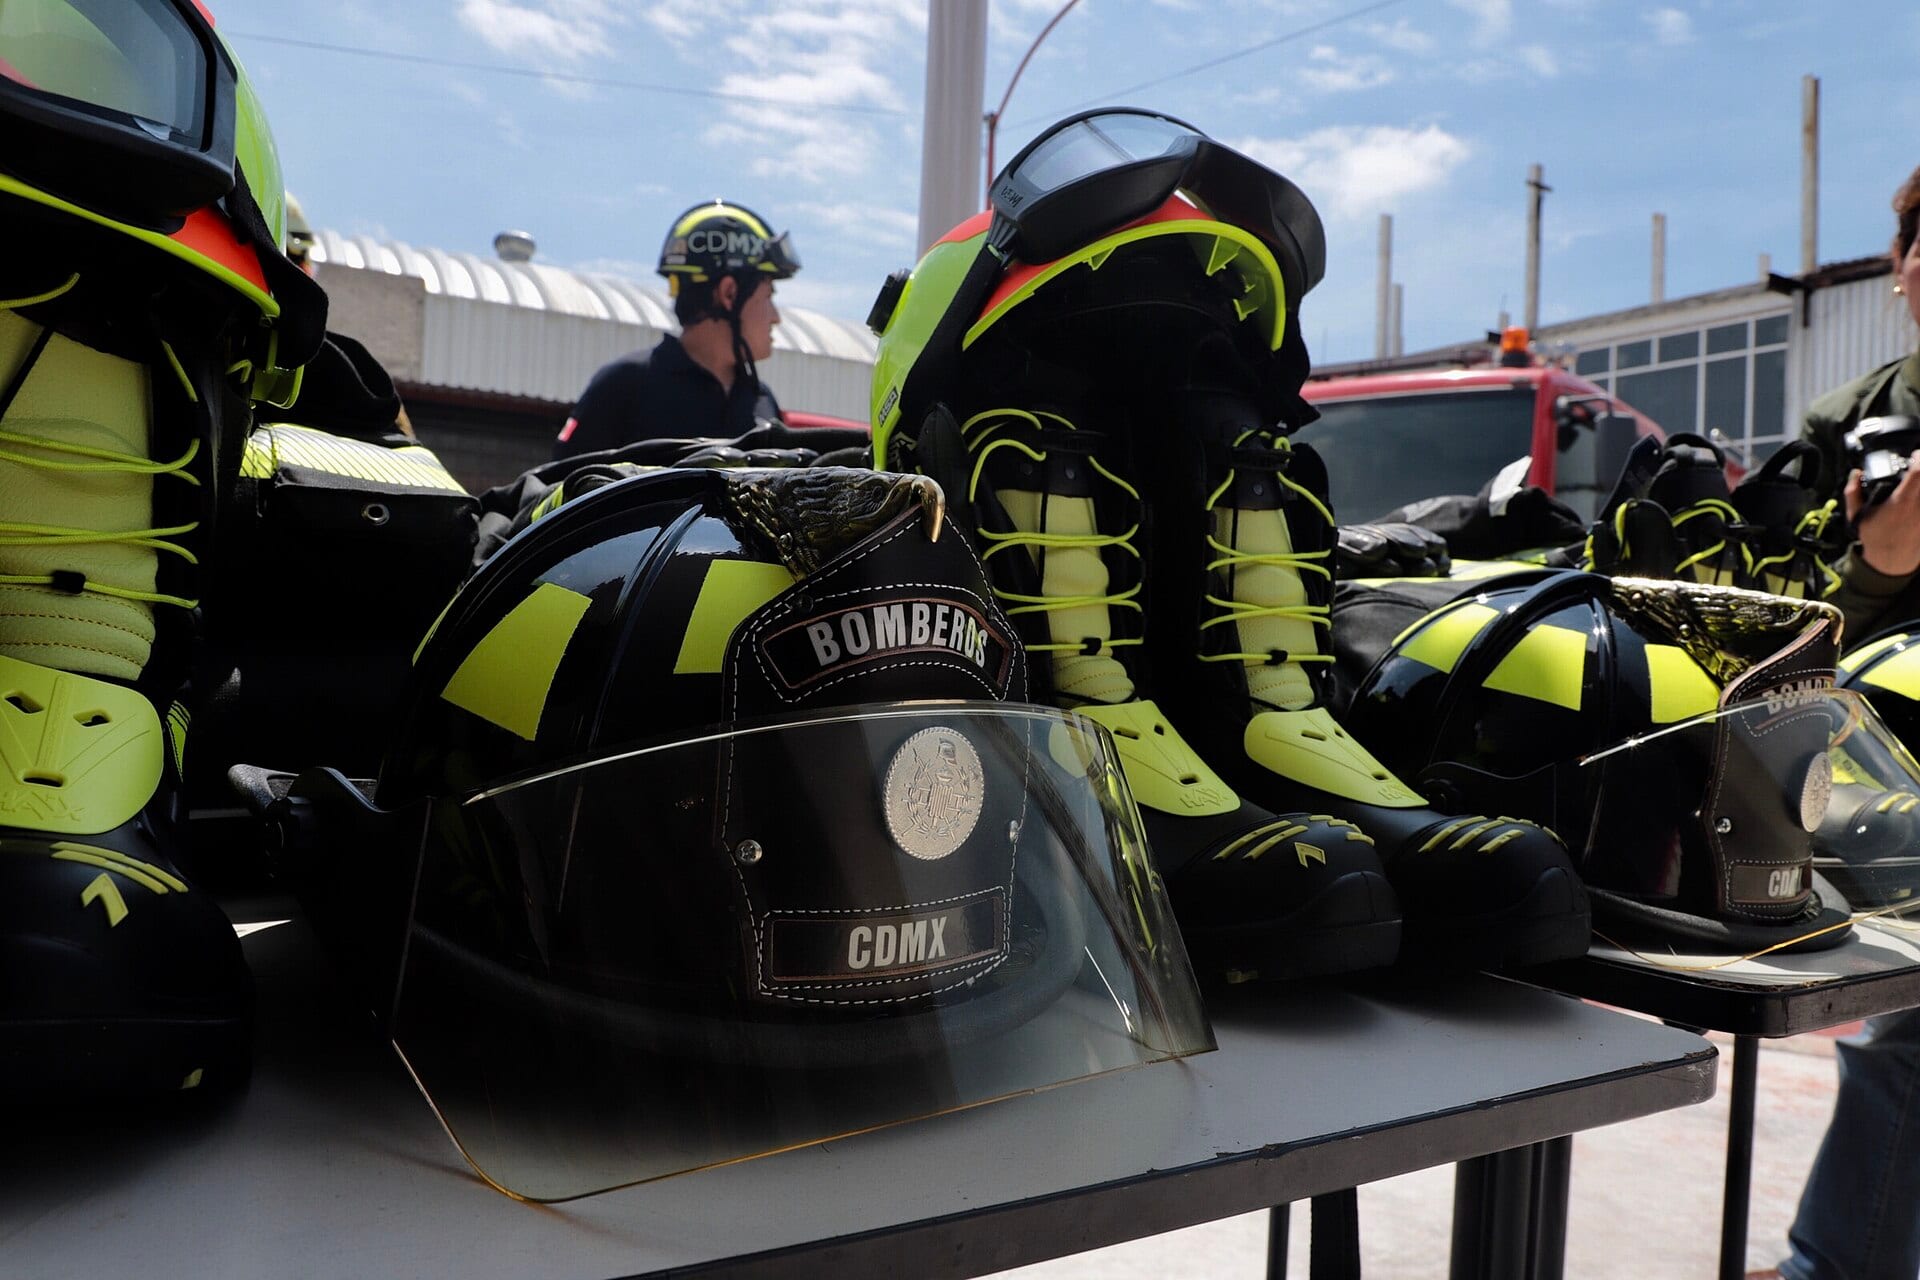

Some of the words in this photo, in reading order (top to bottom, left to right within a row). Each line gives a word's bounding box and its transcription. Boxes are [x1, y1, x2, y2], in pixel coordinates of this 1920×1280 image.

[688, 230, 764, 256] CDMX
[806, 602, 988, 668] BOMBEROS
[848, 916, 948, 970] CDMX
